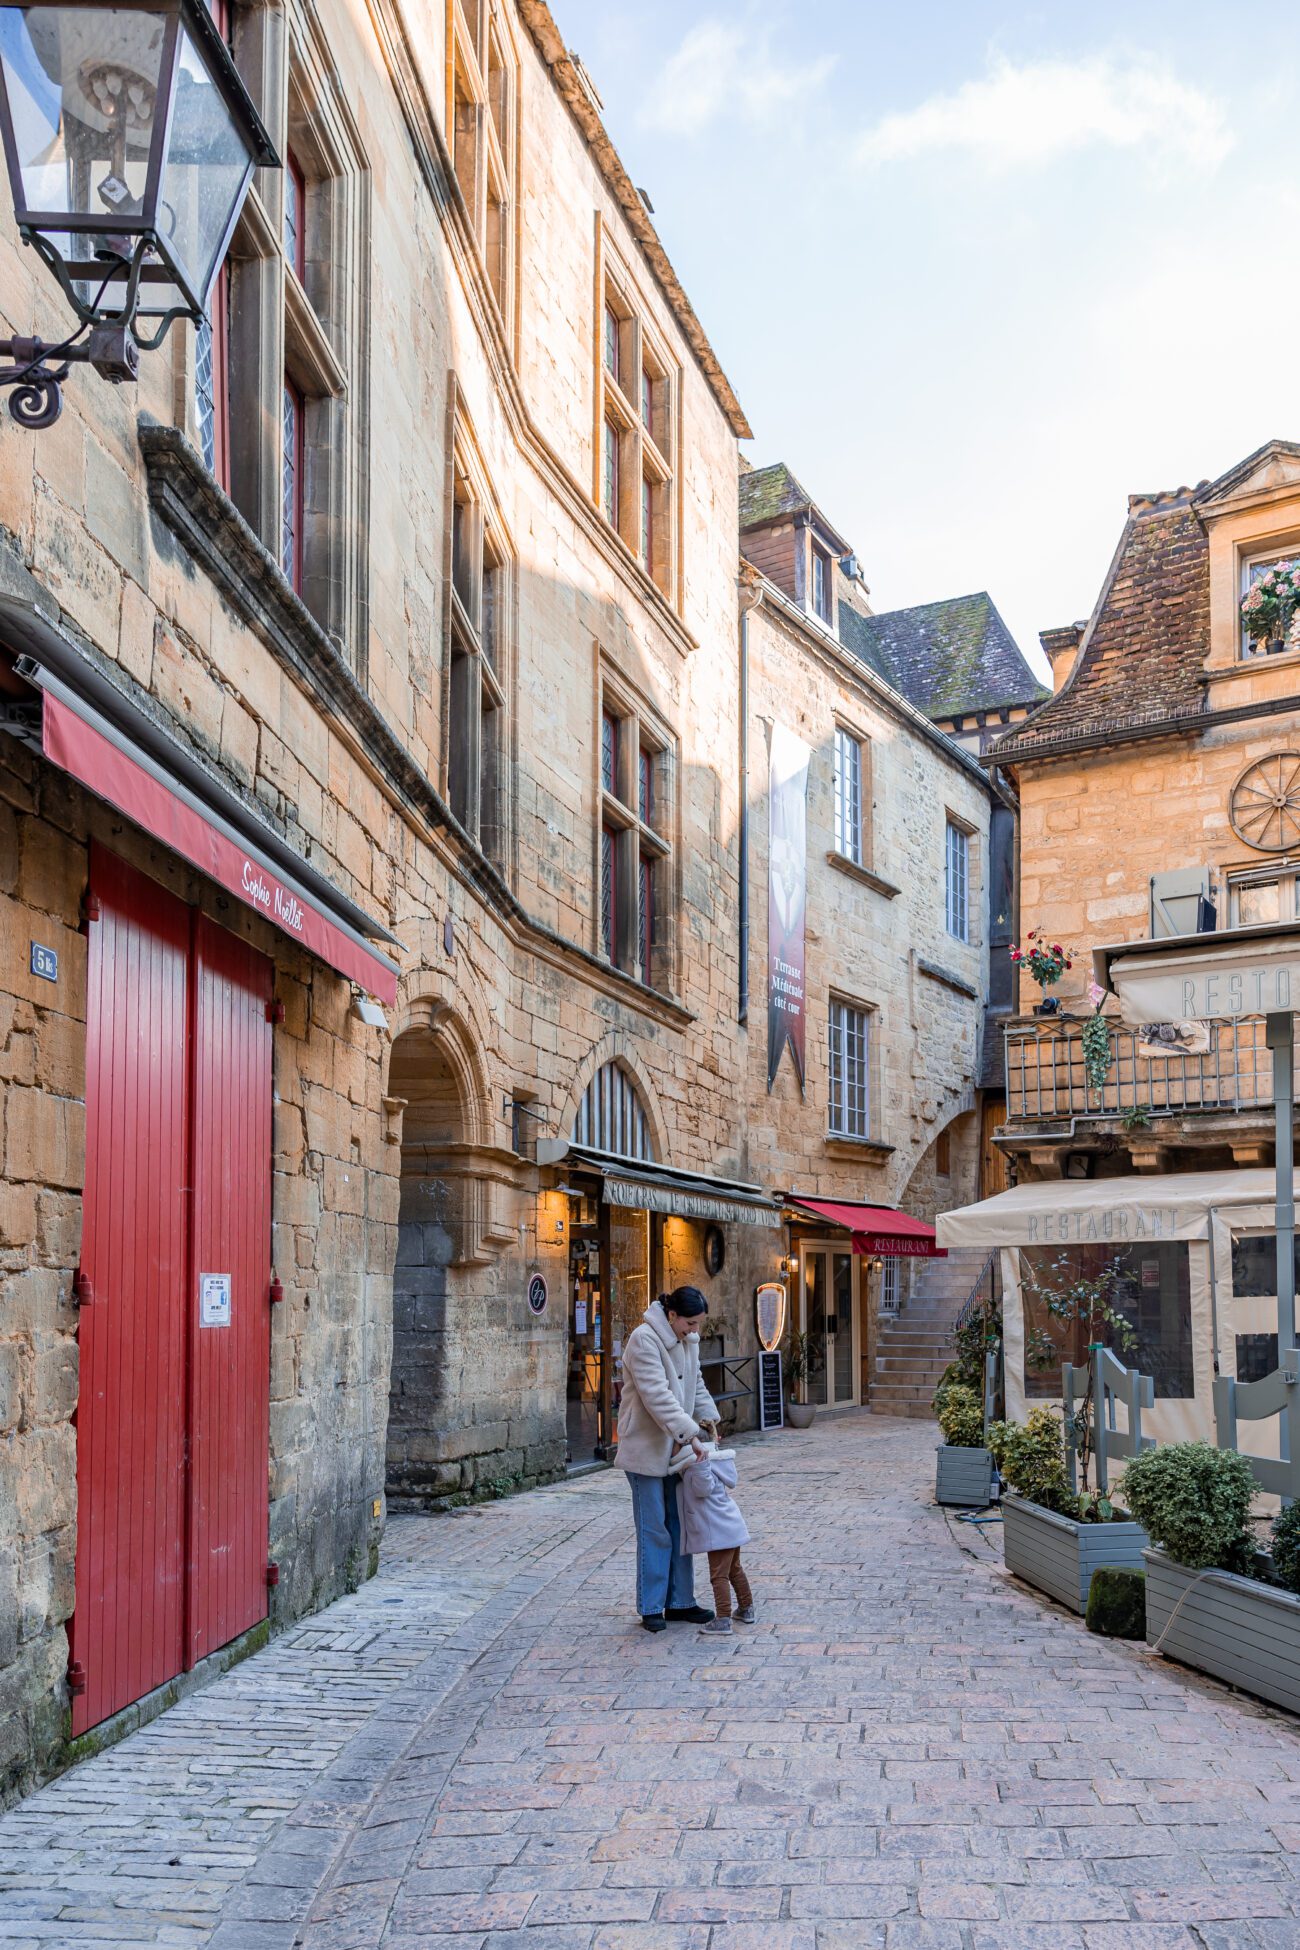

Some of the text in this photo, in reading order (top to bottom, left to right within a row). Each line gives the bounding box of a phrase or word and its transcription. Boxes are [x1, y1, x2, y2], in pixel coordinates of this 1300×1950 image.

[242, 861, 271, 907] Sophie
[38, 951, 44, 969] 5
[774, 957, 800, 980] Terrasse
[772, 975, 803, 999] Médiévale
[1182, 967, 1291, 1018] RESTO
[1028, 1208, 1179, 1242] RESTAURANT
[873, 1238, 930, 1254] RESTAURANT
